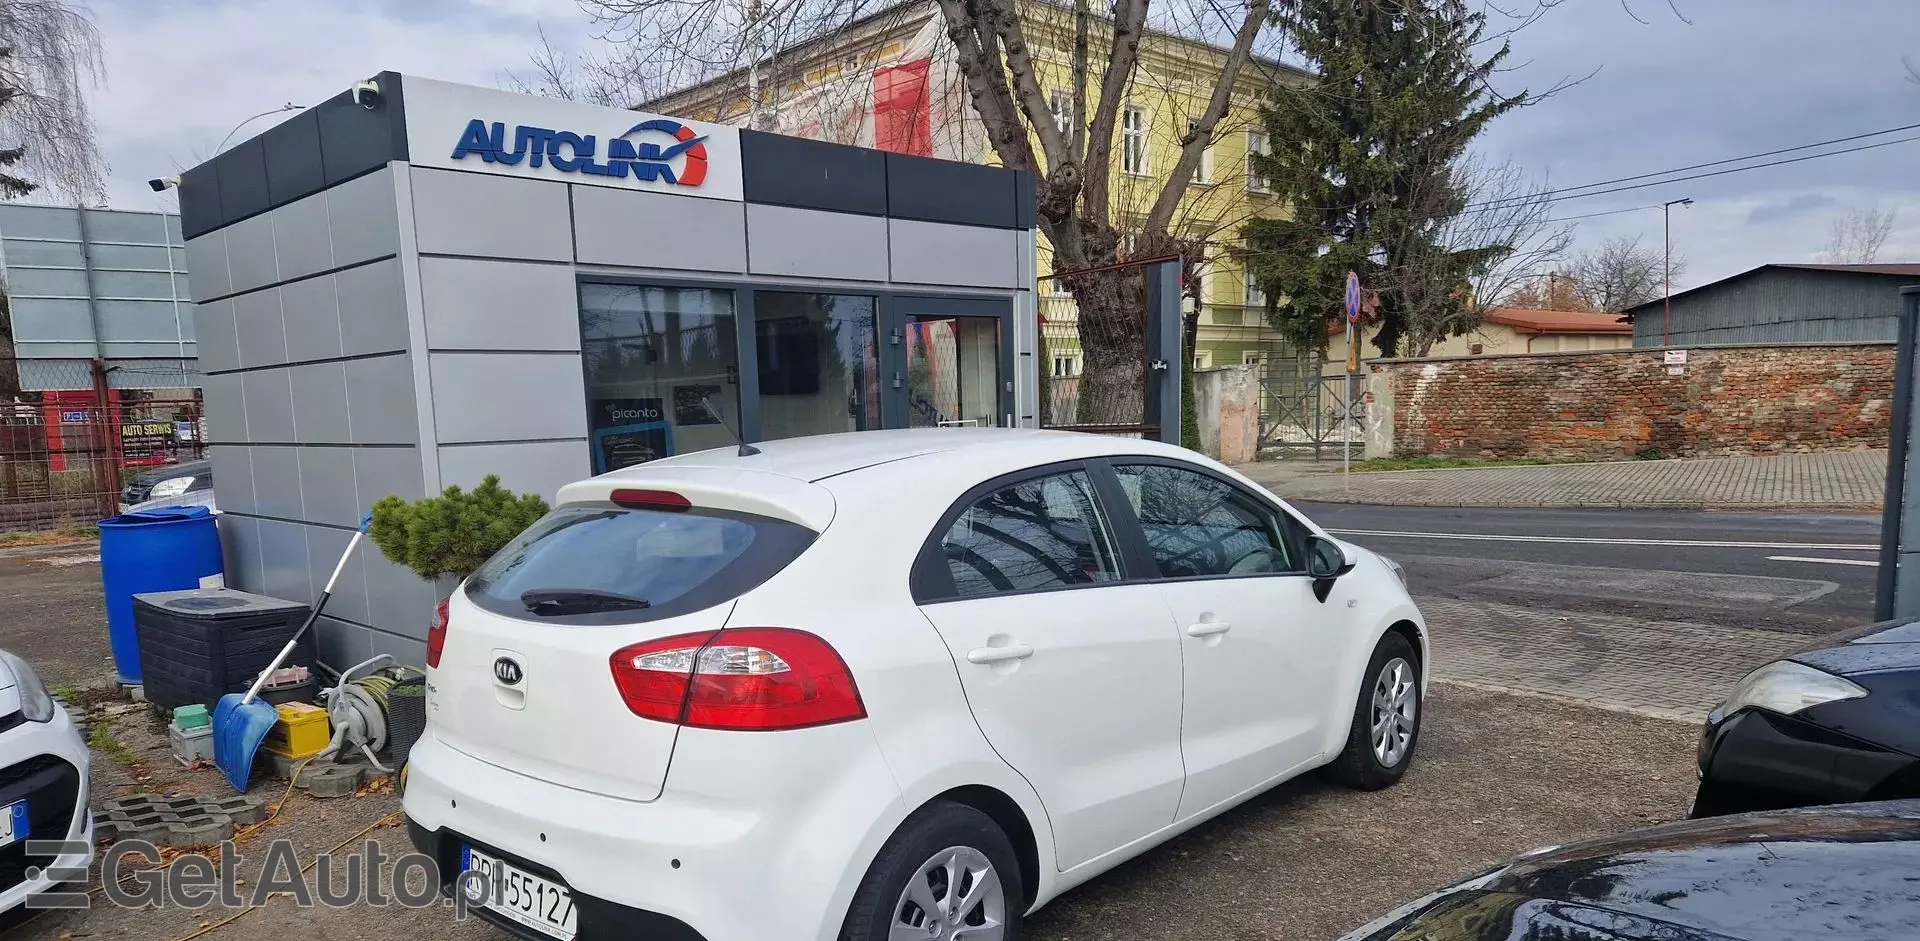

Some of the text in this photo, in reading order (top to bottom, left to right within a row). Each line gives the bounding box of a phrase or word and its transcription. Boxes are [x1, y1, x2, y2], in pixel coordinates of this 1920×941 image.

[451, 118, 706, 186] AUTOLINK
[612, 407, 658, 422] picanto
[122, 423, 172, 436] AUTO SERWIS
[495, 661, 517, 681] KIA
[508, 871, 573, 927] 55127
